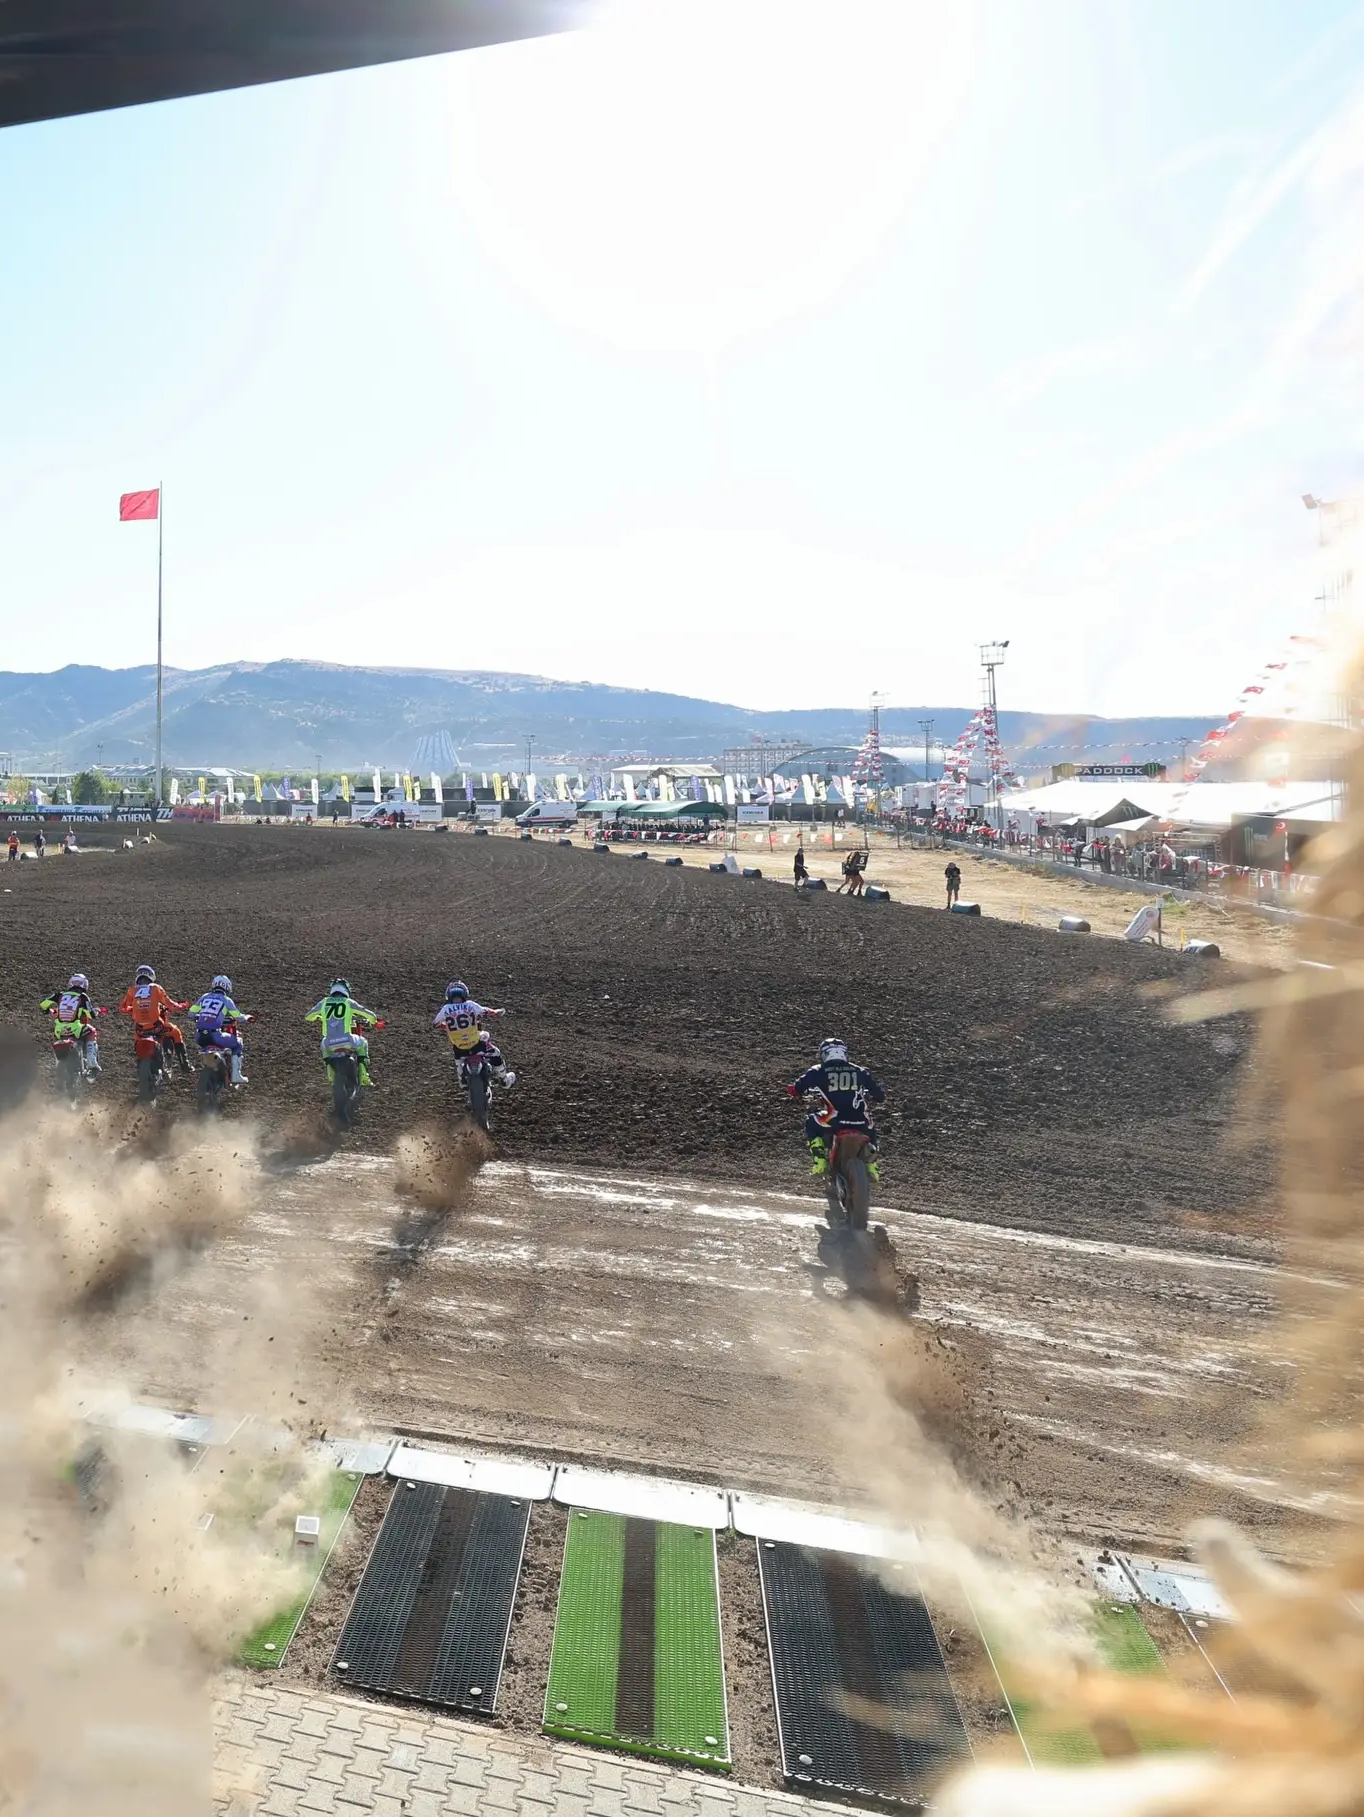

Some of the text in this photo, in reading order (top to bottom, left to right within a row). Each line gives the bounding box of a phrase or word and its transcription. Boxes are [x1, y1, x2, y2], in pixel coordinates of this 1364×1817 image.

[1074, 767, 1144, 775] PADDOCK
[61, 814, 99, 822] ATHENA
[116, 813, 152, 822] ATHENA
[202, 998, 223, 1015] 93
[325, 1002, 346, 1019] 70
[446, 1012, 476, 1032] 261
[828, 1071, 858, 1092] 301
